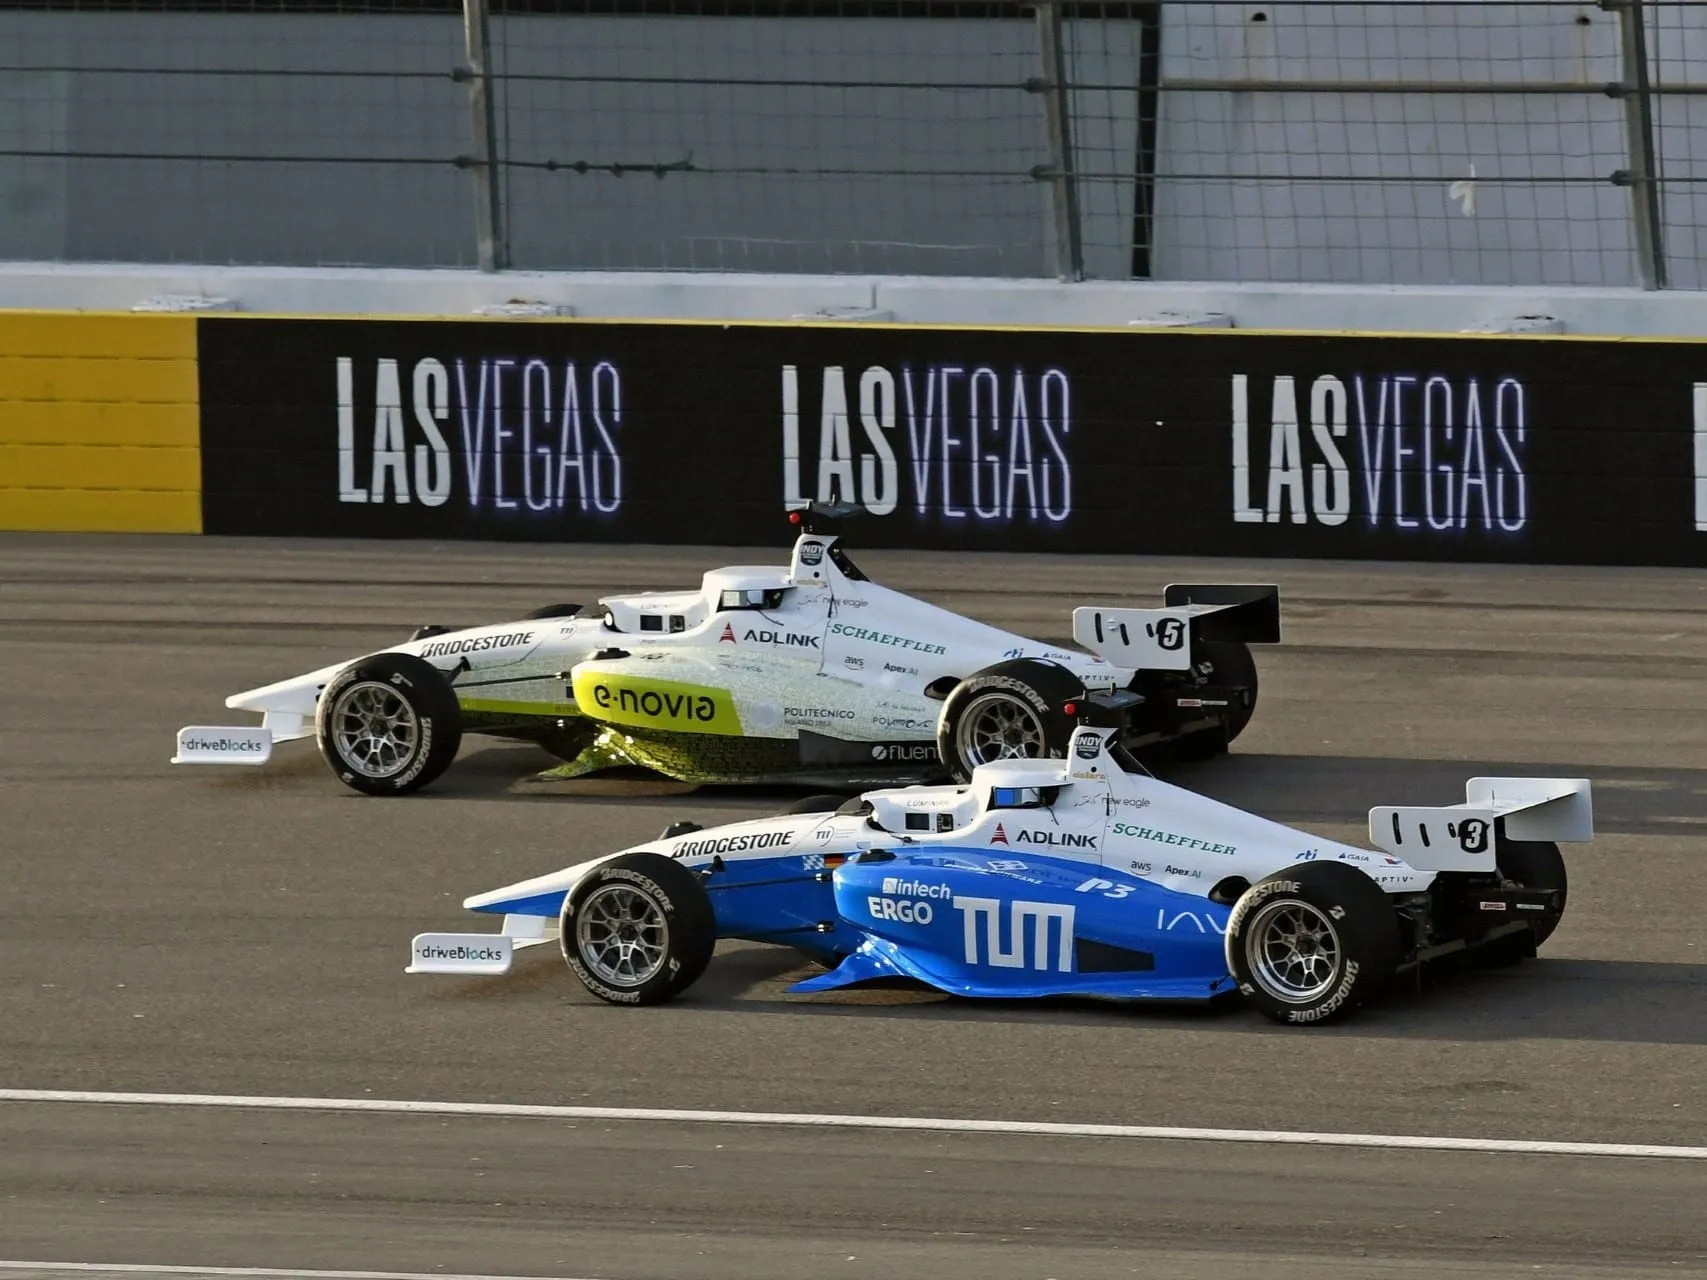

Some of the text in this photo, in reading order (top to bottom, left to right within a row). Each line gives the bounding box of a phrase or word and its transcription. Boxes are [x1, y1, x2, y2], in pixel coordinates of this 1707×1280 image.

[336, 356, 622, 513] LAS VEGAS
[782, 364, 1072, 522] LAS VEGAS
[1232, 373, 1350, 526] LAS
[1355, 375, 1527, 532] VEGAS
[420, 631, 535, 659] BRIDGESTONE
[743, 629, 820, 650] ADLINK
[831, 623, 947, 656] SCHAEFFLER
[1162, 621, 1181, 648] 5
[889, 745, 939, 760] fluen
[1075, 736, 1103, 746] INDY
[1123, 798, 1151, 809] eagle
[670, 830, 796, 859] BRIDGESTONE
[1016, 829, 1098, 849] ADLINK
[1112, 822, 1237, 856] SCHAEFFLER
[1465, 820, 1483, 849] 3
[1130, 860, 1152, 872] aws
[897, 878, 950, 900] intech
[1075, 877, 1137, 899] P3
[867, 896, 933, 925] ERGO
